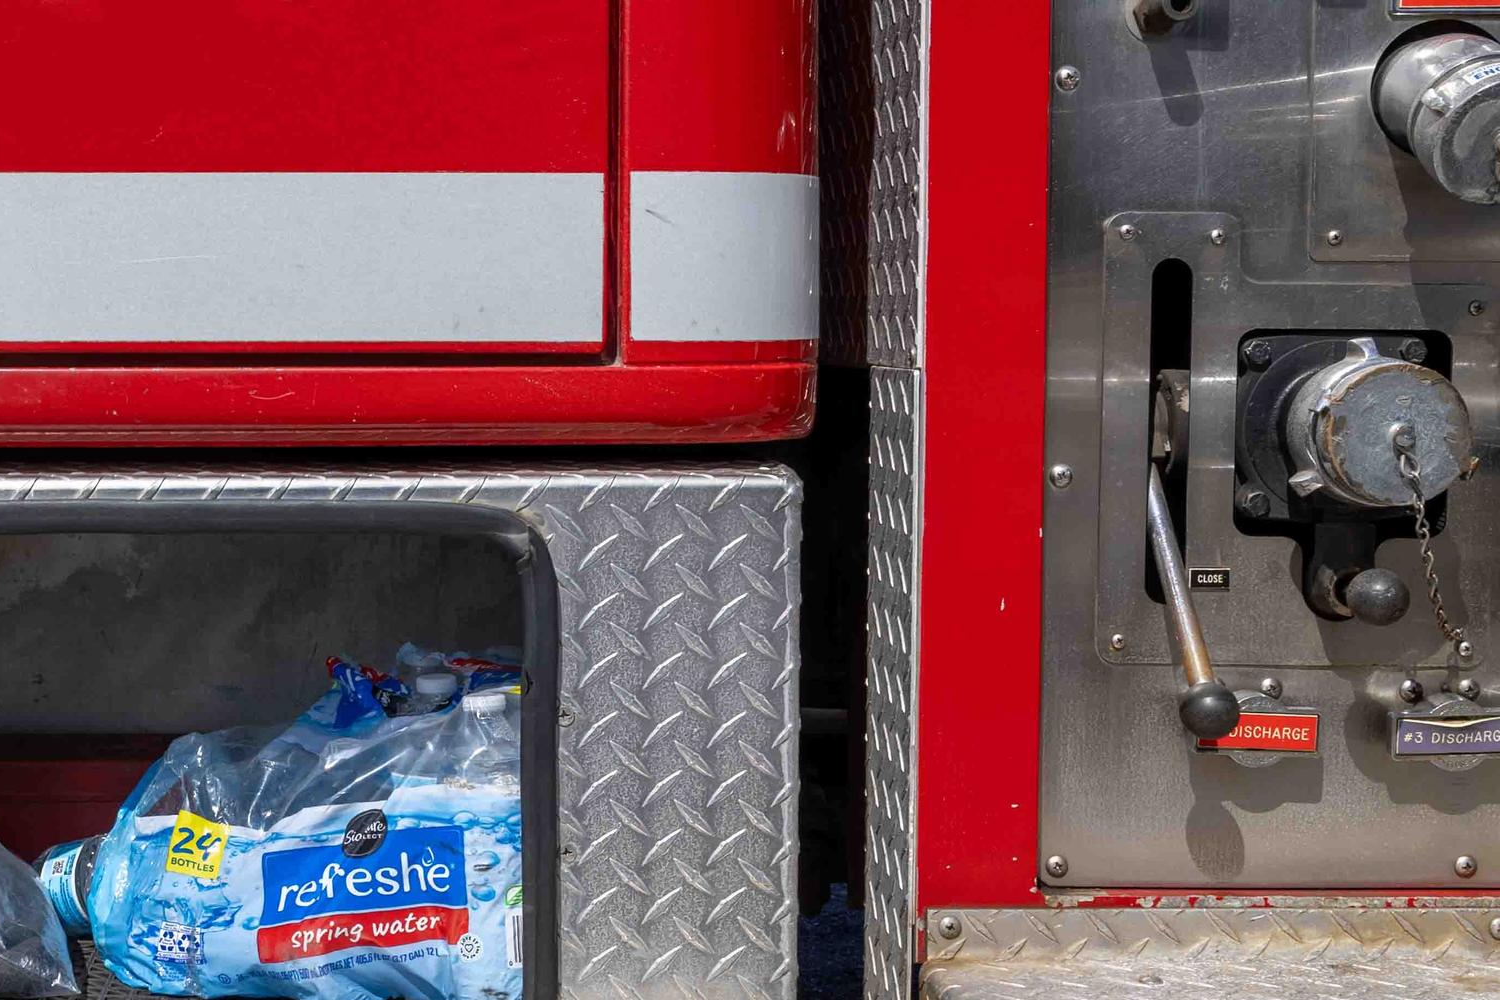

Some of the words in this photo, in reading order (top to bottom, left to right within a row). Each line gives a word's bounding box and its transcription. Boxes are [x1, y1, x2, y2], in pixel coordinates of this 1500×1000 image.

[1197, 574, 1224, 584] CLOSE
[1404, 731, 1424, 744] #3
[172, 826, 222, 861] 24
[171, 857, 215, 873] BOTTLES
[291, 921, 363, 953] spring
[372, 912, 441, 936] water
[426, 947, 435, 956] 12
